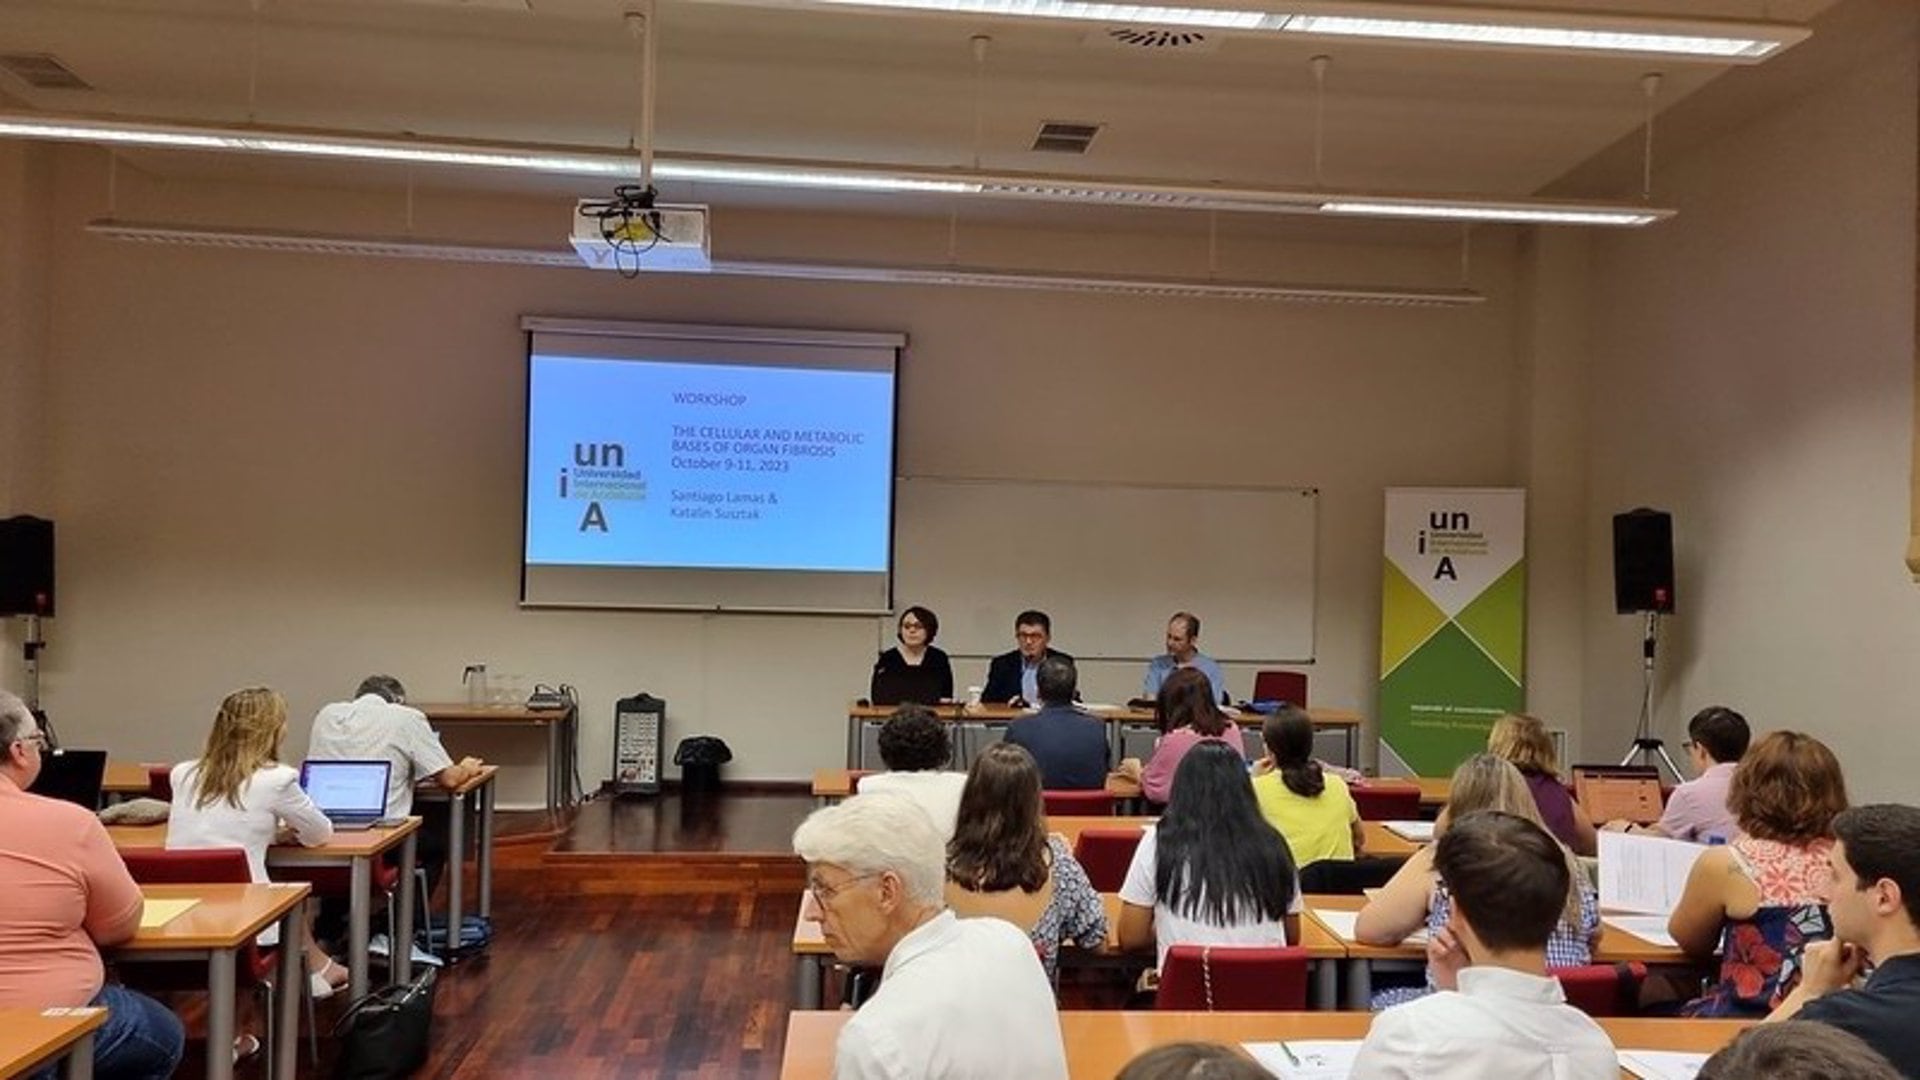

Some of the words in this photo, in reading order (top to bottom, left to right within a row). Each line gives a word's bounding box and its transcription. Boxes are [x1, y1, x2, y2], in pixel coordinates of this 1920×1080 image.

[672, 392, 747, 406] WORKSHOP
[672, 425, 696, 437] THE
[700, 426, 760, 440] CELLULAR
[762, 429, 791, 441] AND
[794, 430, 864, 445] METABOLIC
[575, 443, 624, 467] un
[672, 439, 711, 452] BASES
[712, 441, 730, 453] OF
[733, 441, 779, 455] ORGAN
[782, 443, 836, 458] FIBROSIS
[671, 456, 722, 470] October
[759, 459, 788, 473] 2023
[671, 489, 724, 504] Santiago
[726, 491, 765, 503] Lamas
[767, 492, 779, 504] &
[580, 502, 608, 533] A
[671, 507, 712, 519] Katalin
[714, 507, 760, 519] Susztak
[1430, 511, 1469, 530] un
[1419, 530, 1425, 555] i
[1434, 556, 1457, 580] A
